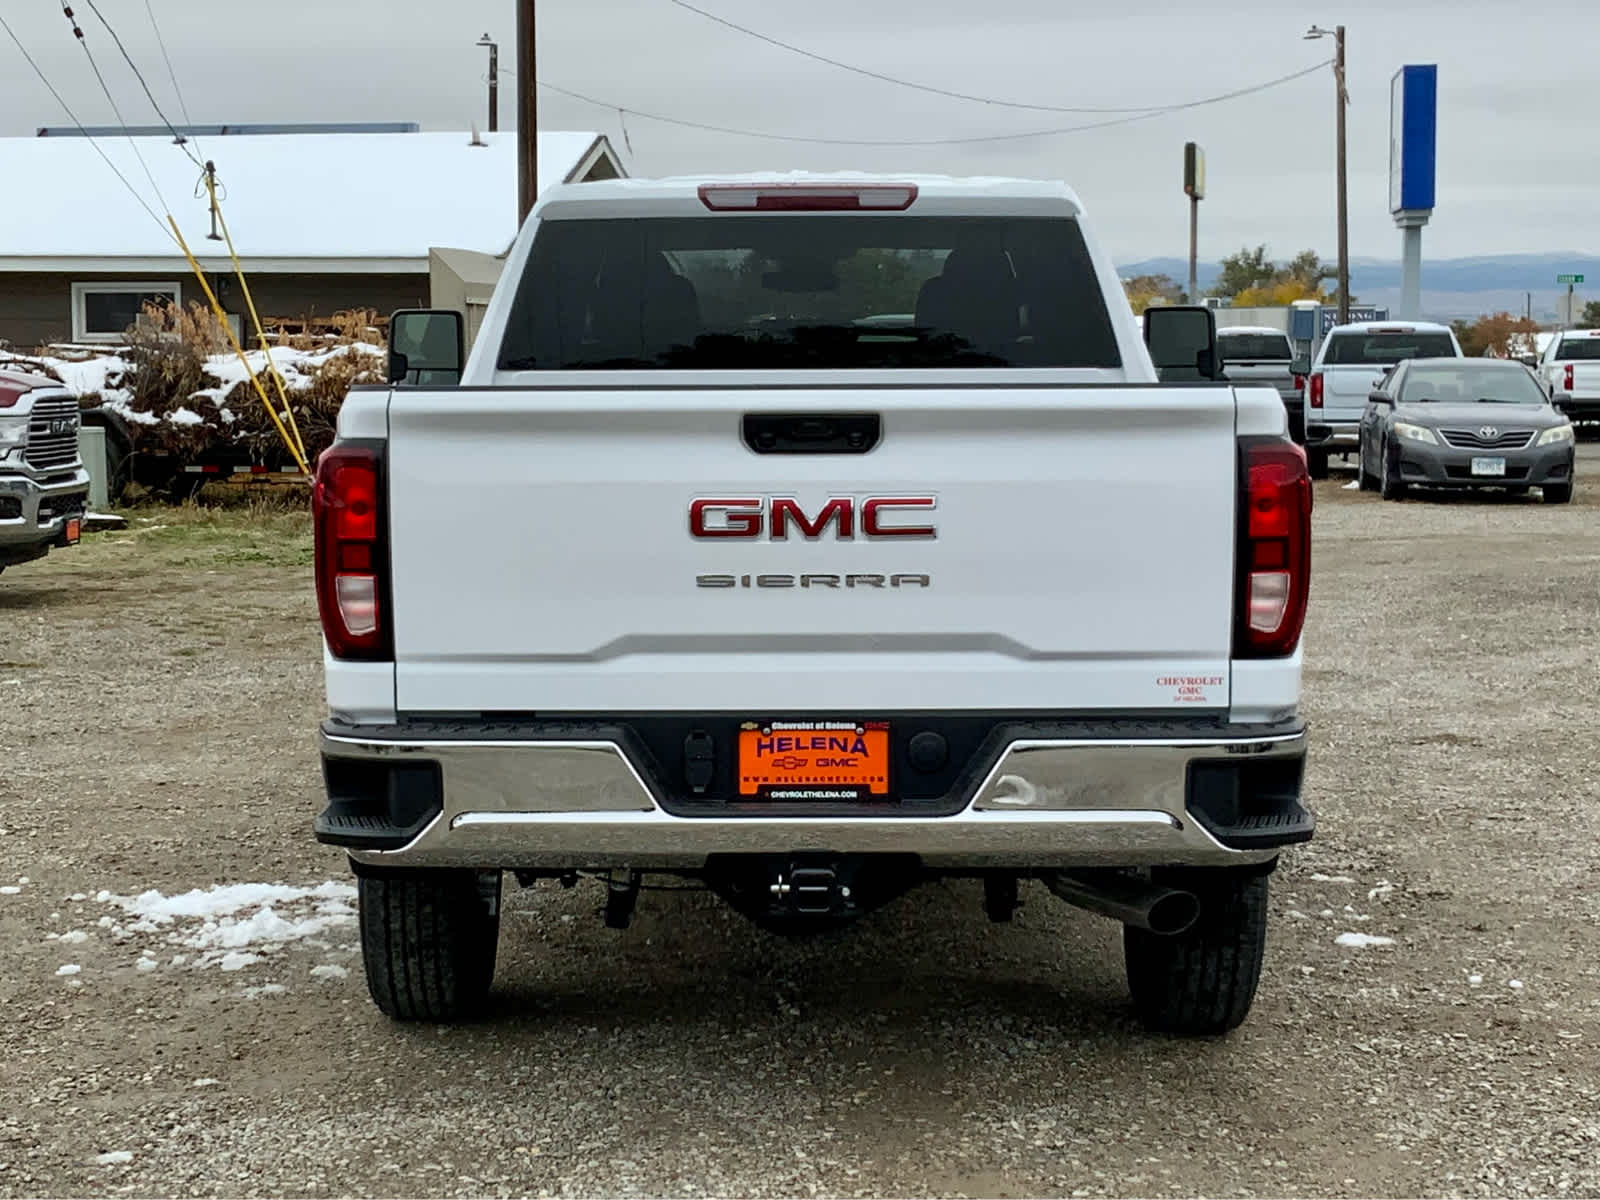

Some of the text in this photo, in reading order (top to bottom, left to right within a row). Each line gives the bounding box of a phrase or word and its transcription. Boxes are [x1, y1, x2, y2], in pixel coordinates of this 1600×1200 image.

[689, 496, 937, 541] GMC
[696, 574, 930, 588] SIERRA
[1156, 676, 1224, 686] CHEVROLET
[1178, 687, 1203, 695] GMC
[756, 736, 869, 758] HELENA
[815, 758, 858, 767] GMC
